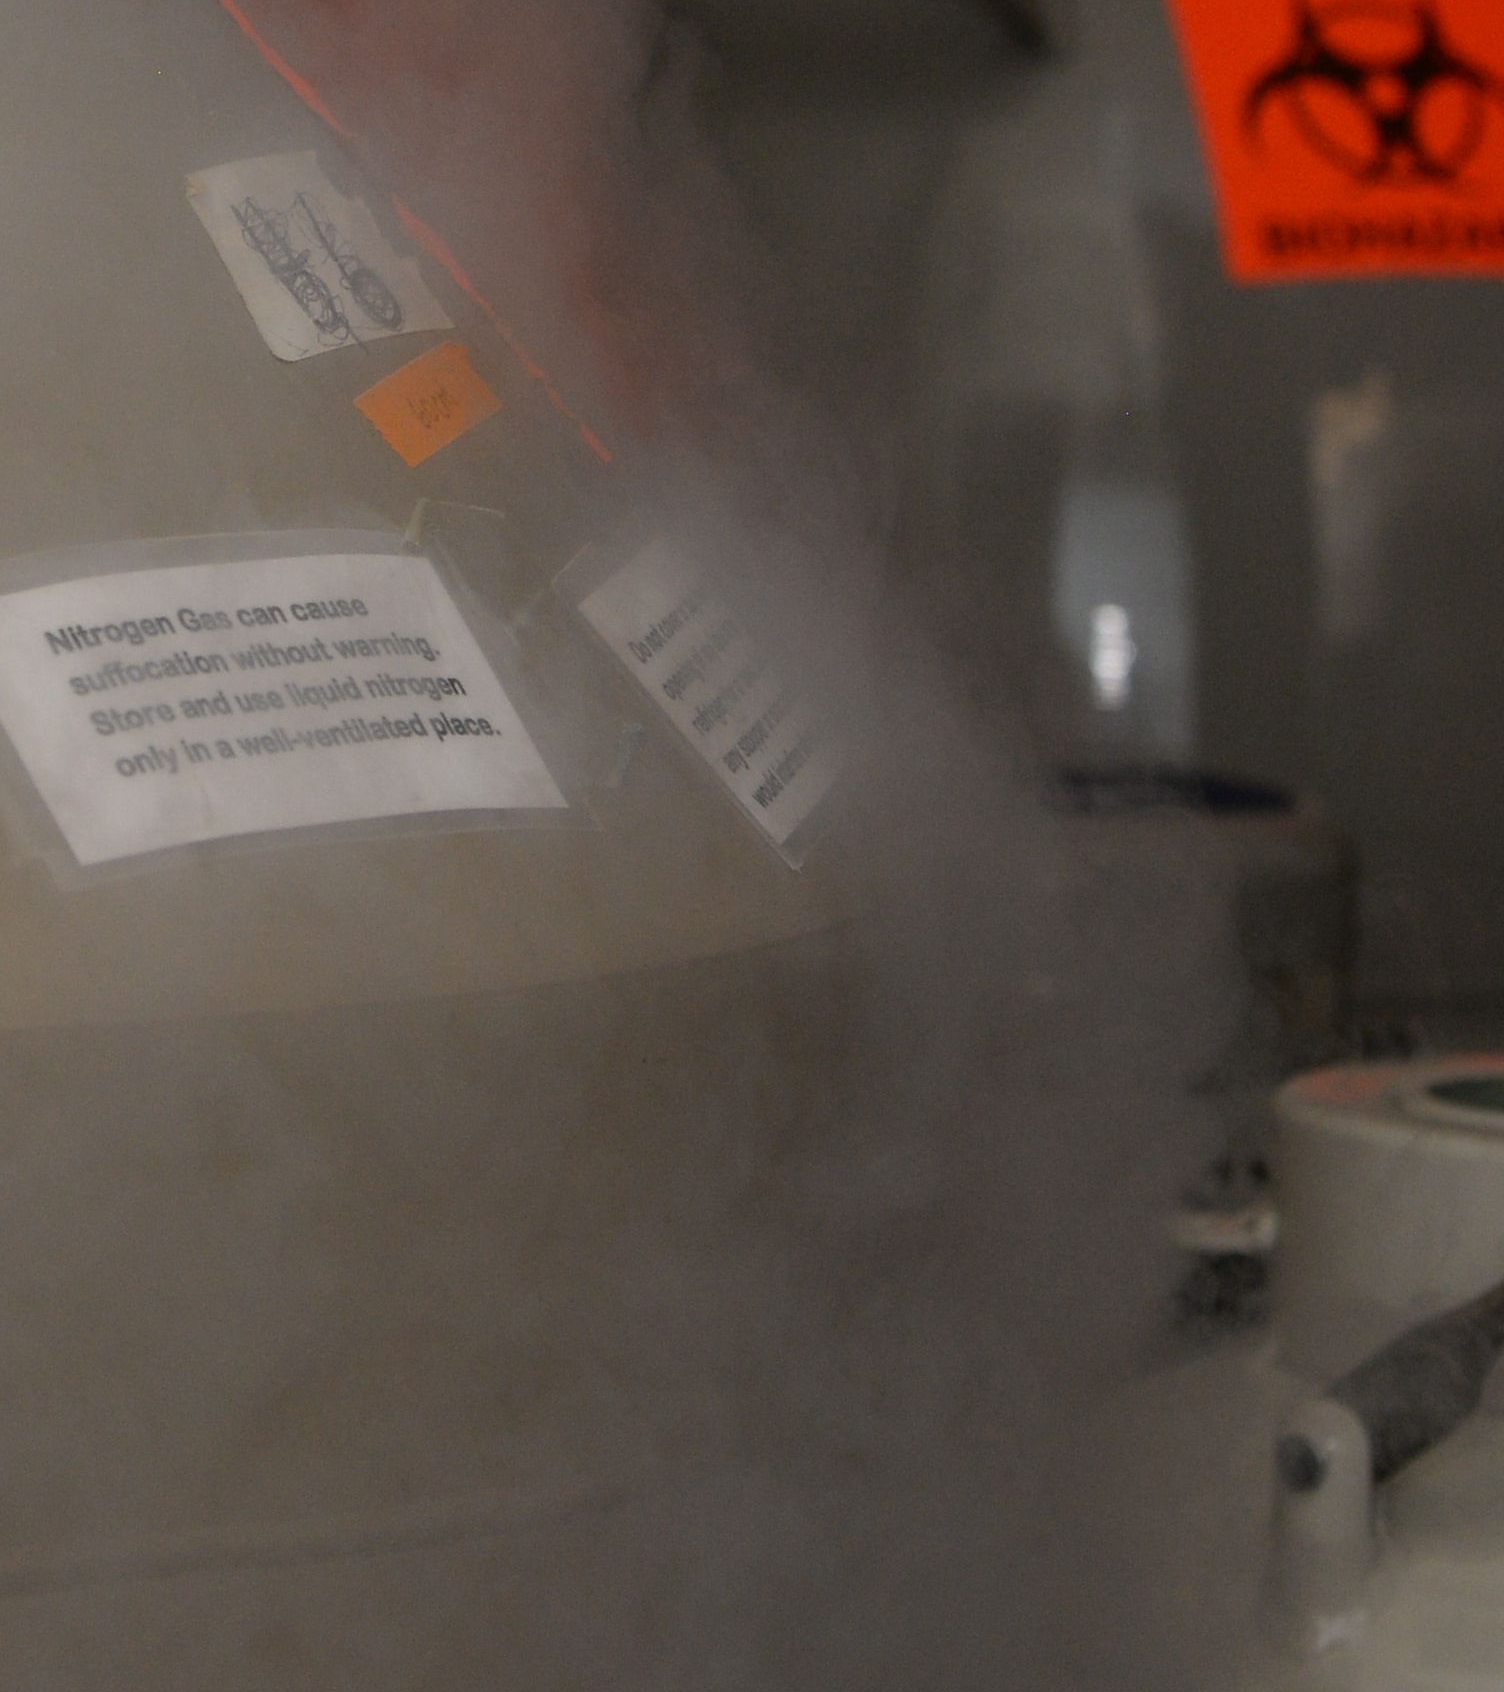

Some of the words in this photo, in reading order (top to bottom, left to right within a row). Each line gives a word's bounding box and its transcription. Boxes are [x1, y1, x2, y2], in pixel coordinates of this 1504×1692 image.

[44, 615, 176, 654] Nitrogen
[177, 607, 233, 633] Gas
[236, 604, 288, 627] can
[289, 597, 369, 622] cause
[69, 651, 230, 696] suffocation
[231, 637, 334, 670] without
[333, 631, 441, 662] warning.
[90, 703, 176, 736] Store
[179, 689, 232, 719] and
[233, 689, 285, 713] use
[285, 675, 364, 710] liquid
[363, 672, 468, 701] nitrogen
[115, 743, 179, 778] only
[180, 738, 212, 763] in
[214, 739, 237, 760] a
[235, 711, 428, 758] well-ventilated
[428, 711, 502, 742] place.
